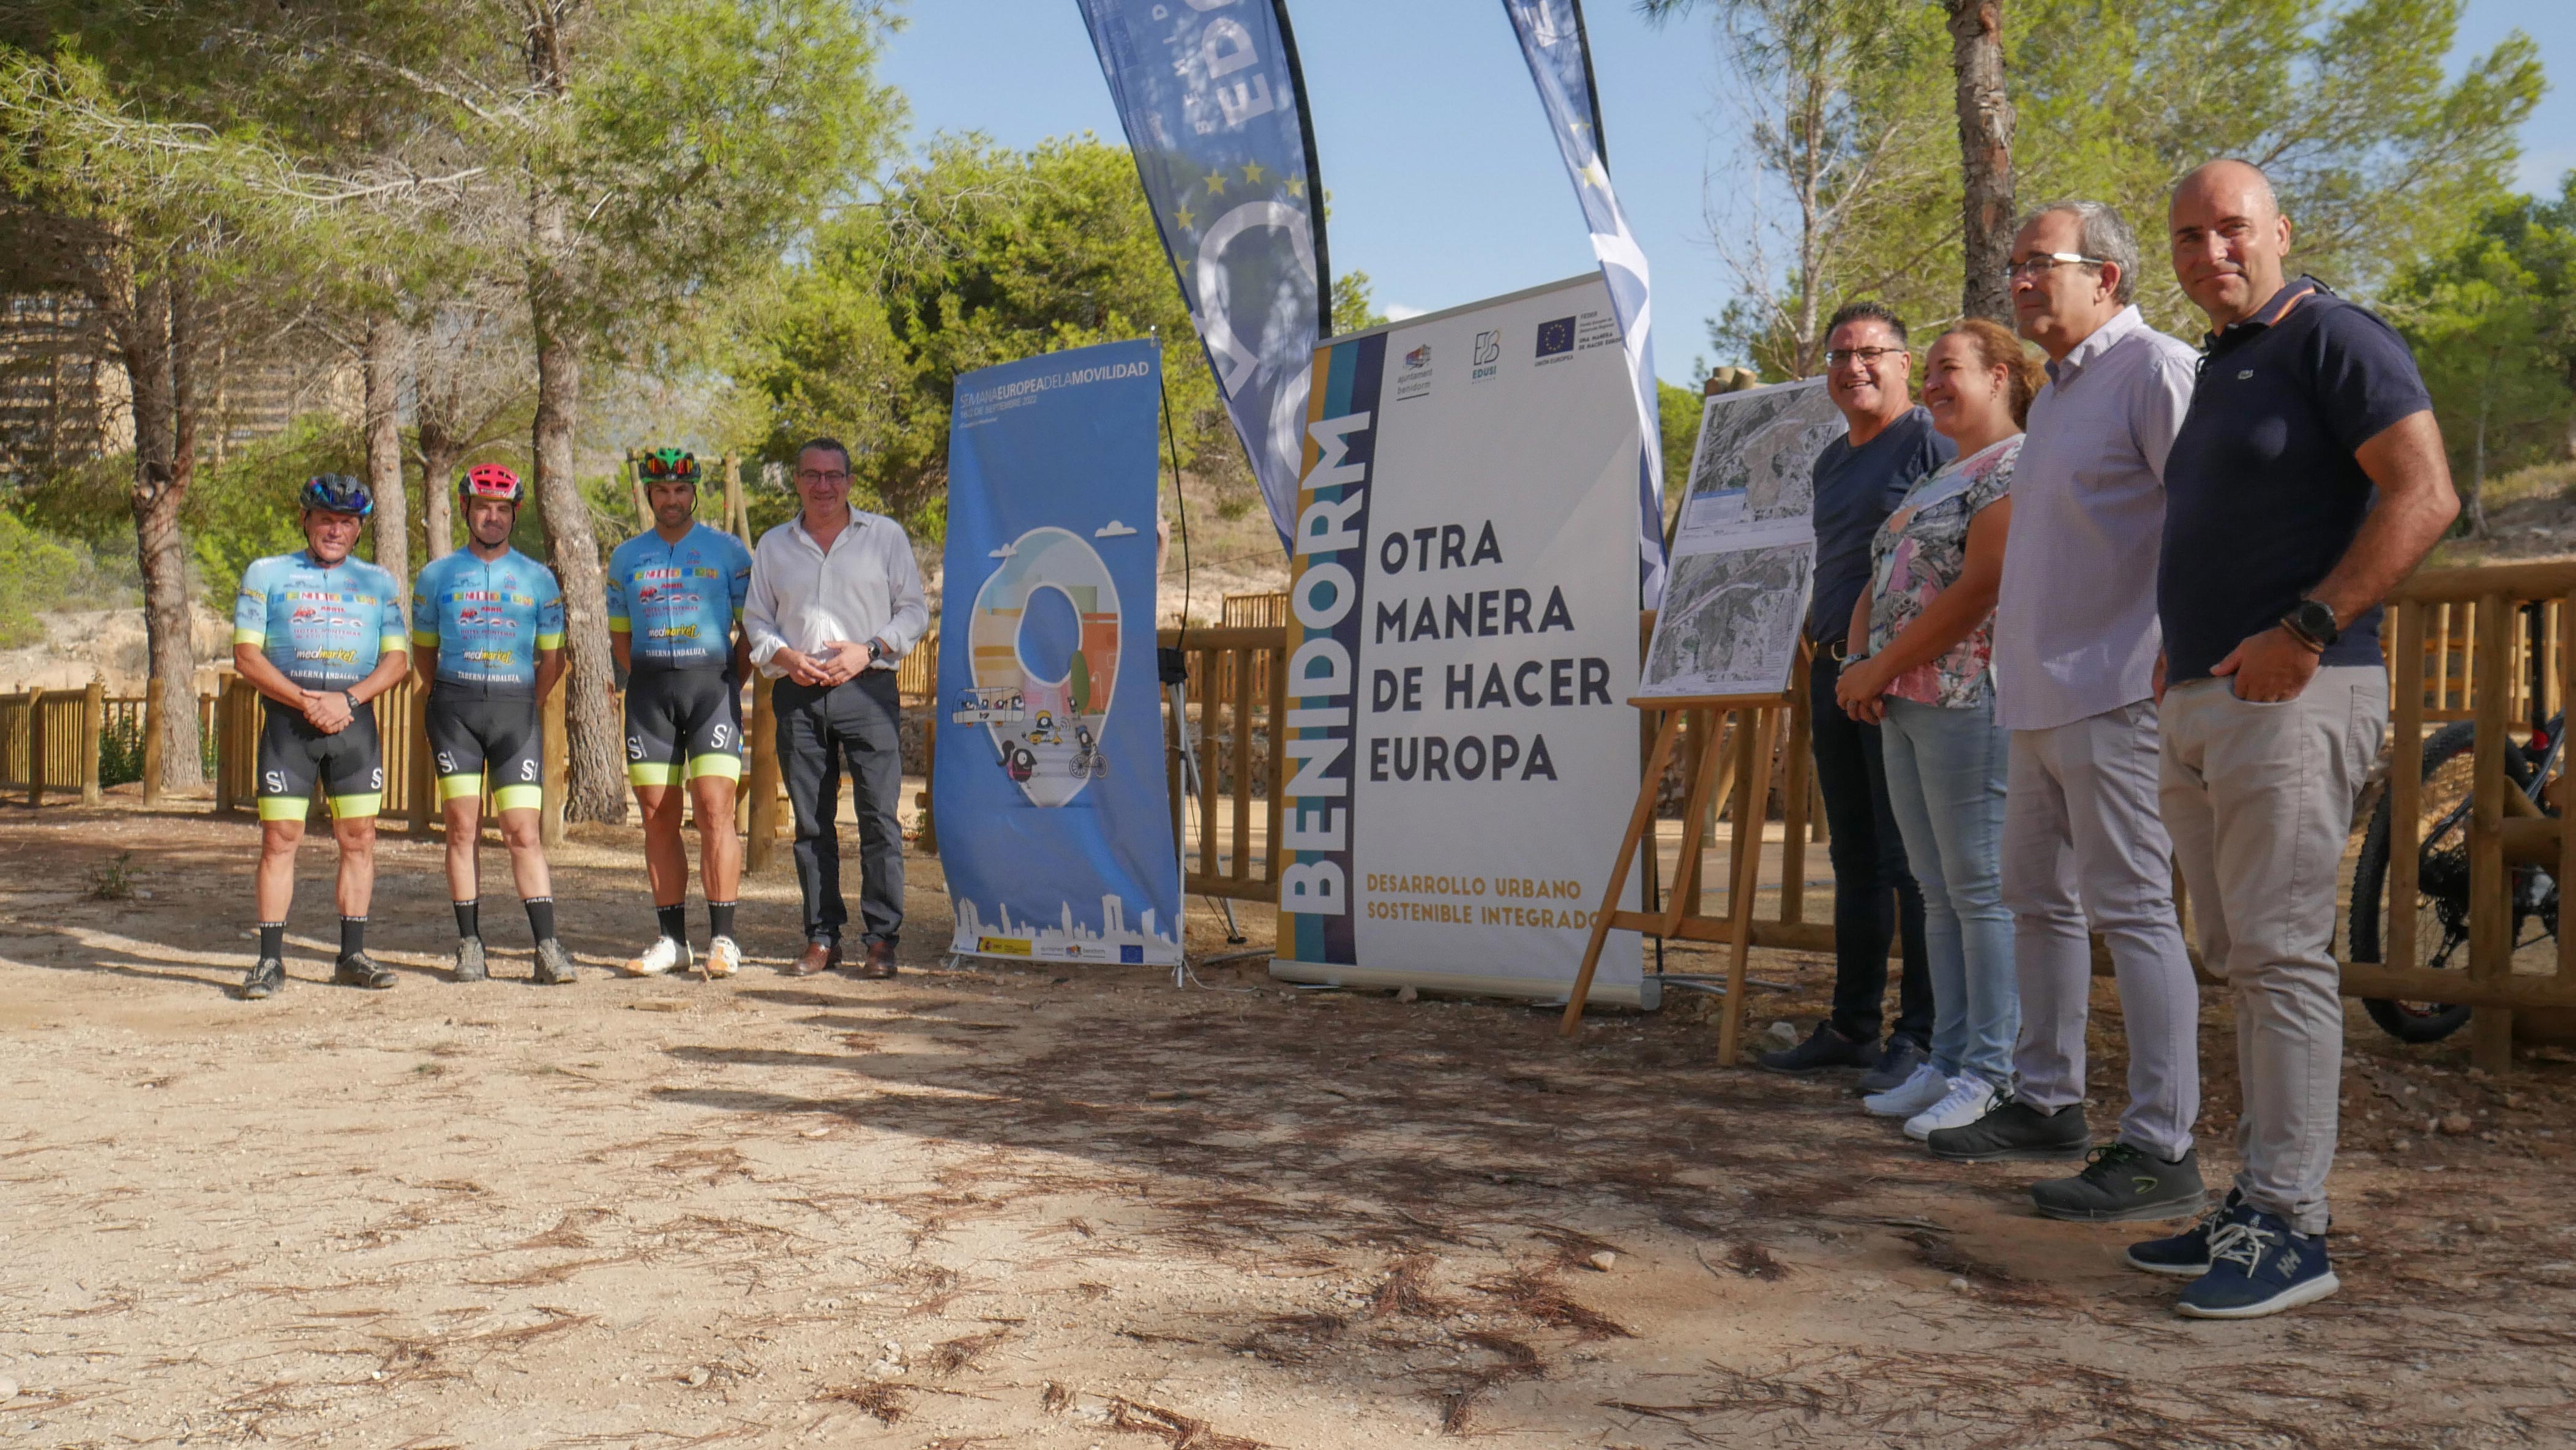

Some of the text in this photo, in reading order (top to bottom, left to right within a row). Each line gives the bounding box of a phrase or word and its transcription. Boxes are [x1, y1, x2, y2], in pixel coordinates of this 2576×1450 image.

[1472, 365, 1497, 379] EDUSI
[1380, 520, 1503, 575] OTRA
[1376, 585, 1574, 643] MANERA
[1281, 410, 1371, 916] BENIDORM
[1372, 657, 1612, 713] DE HACER
[1370, 734, 1558, 782] EUROPA
[1367, 873, 1582, 900] DESARROLLO URBANO
[1367, 900, 1473, 924] SOSTENIBLE
